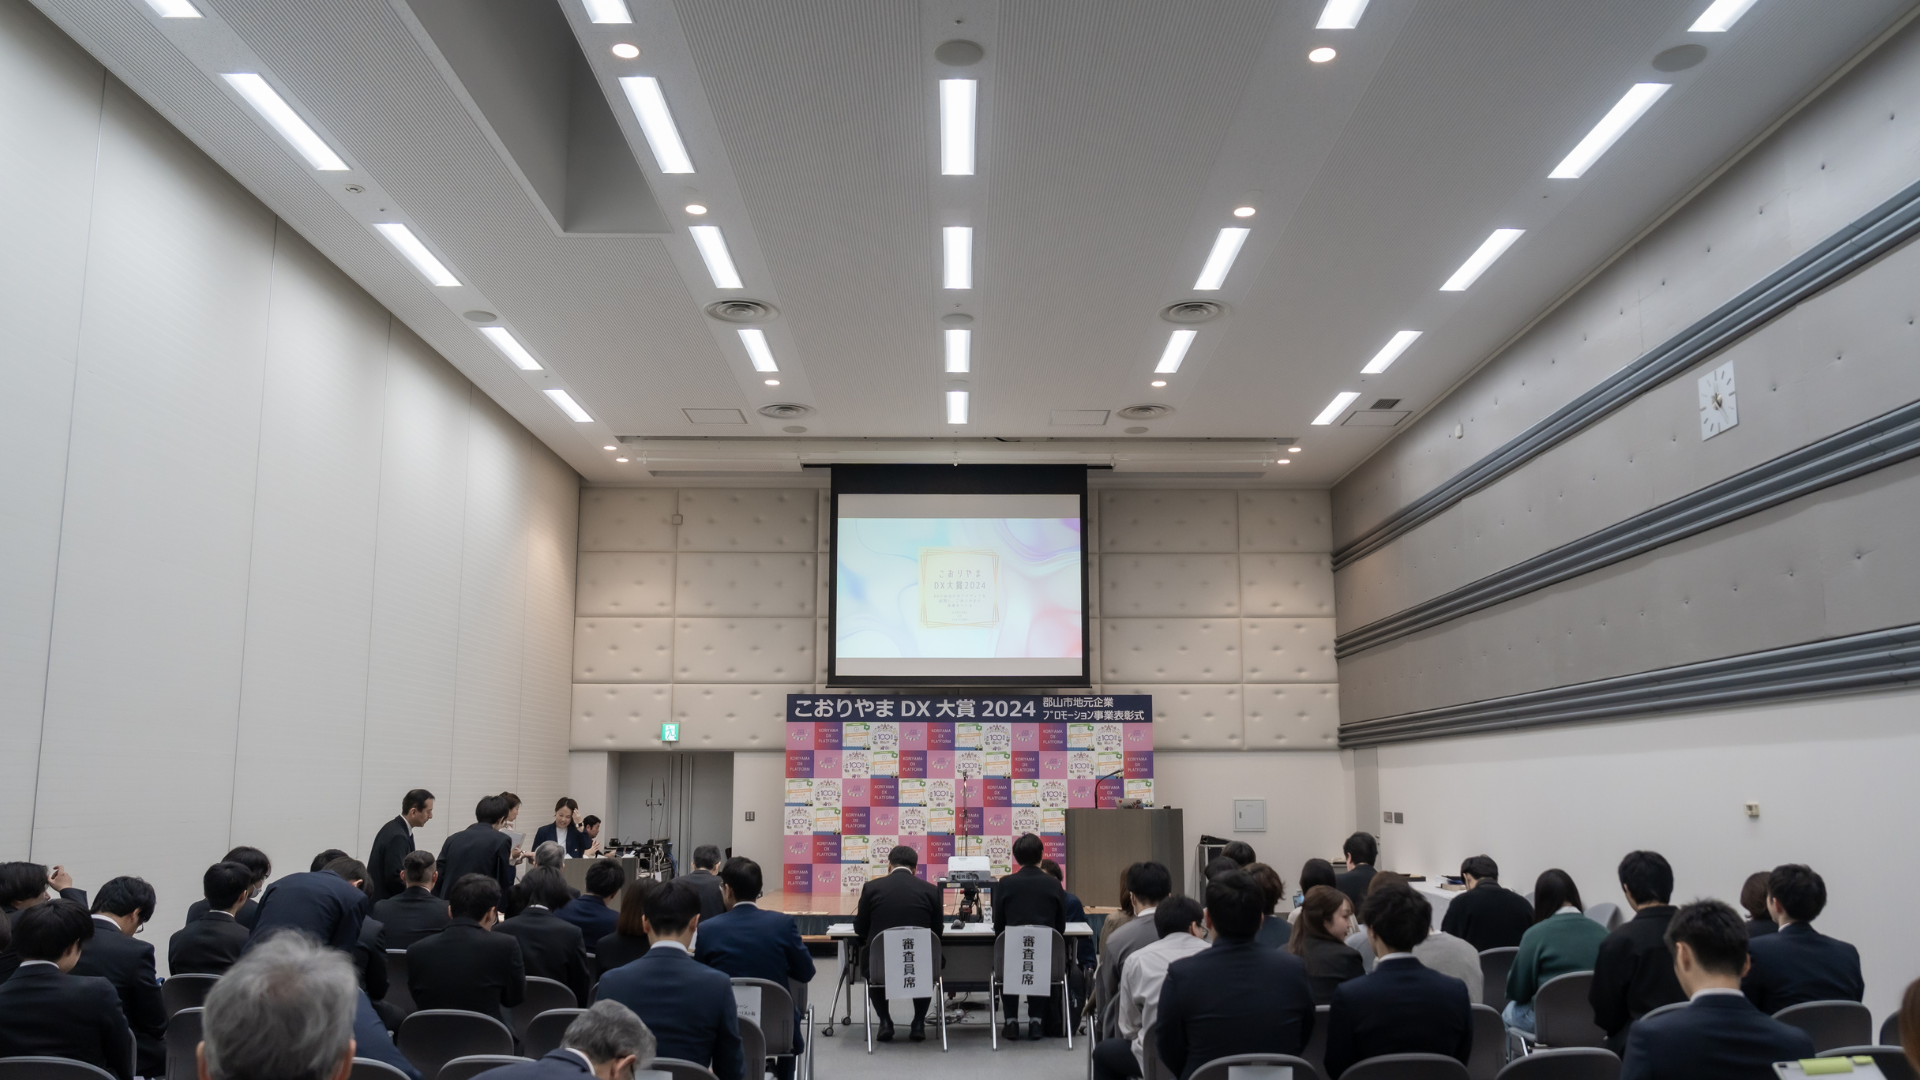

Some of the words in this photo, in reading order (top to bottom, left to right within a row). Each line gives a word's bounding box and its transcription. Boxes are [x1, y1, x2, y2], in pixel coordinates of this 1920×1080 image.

[939, 570, 981, 578] こおりやま
[934, 581, 986, 590] DX大賞2024
[794, 699, 894, 717] こおりやま
[901, 701, 931, 717] DX
[936, 699, 975, 718] 大賞
[982, 701, 1036, 717] 2024
[1043, 697, 1114, 708] 郡山市地元企業
[902, 938, 916, 988] 審査員席
[1021, 936, 1035, 986] 審査員席
